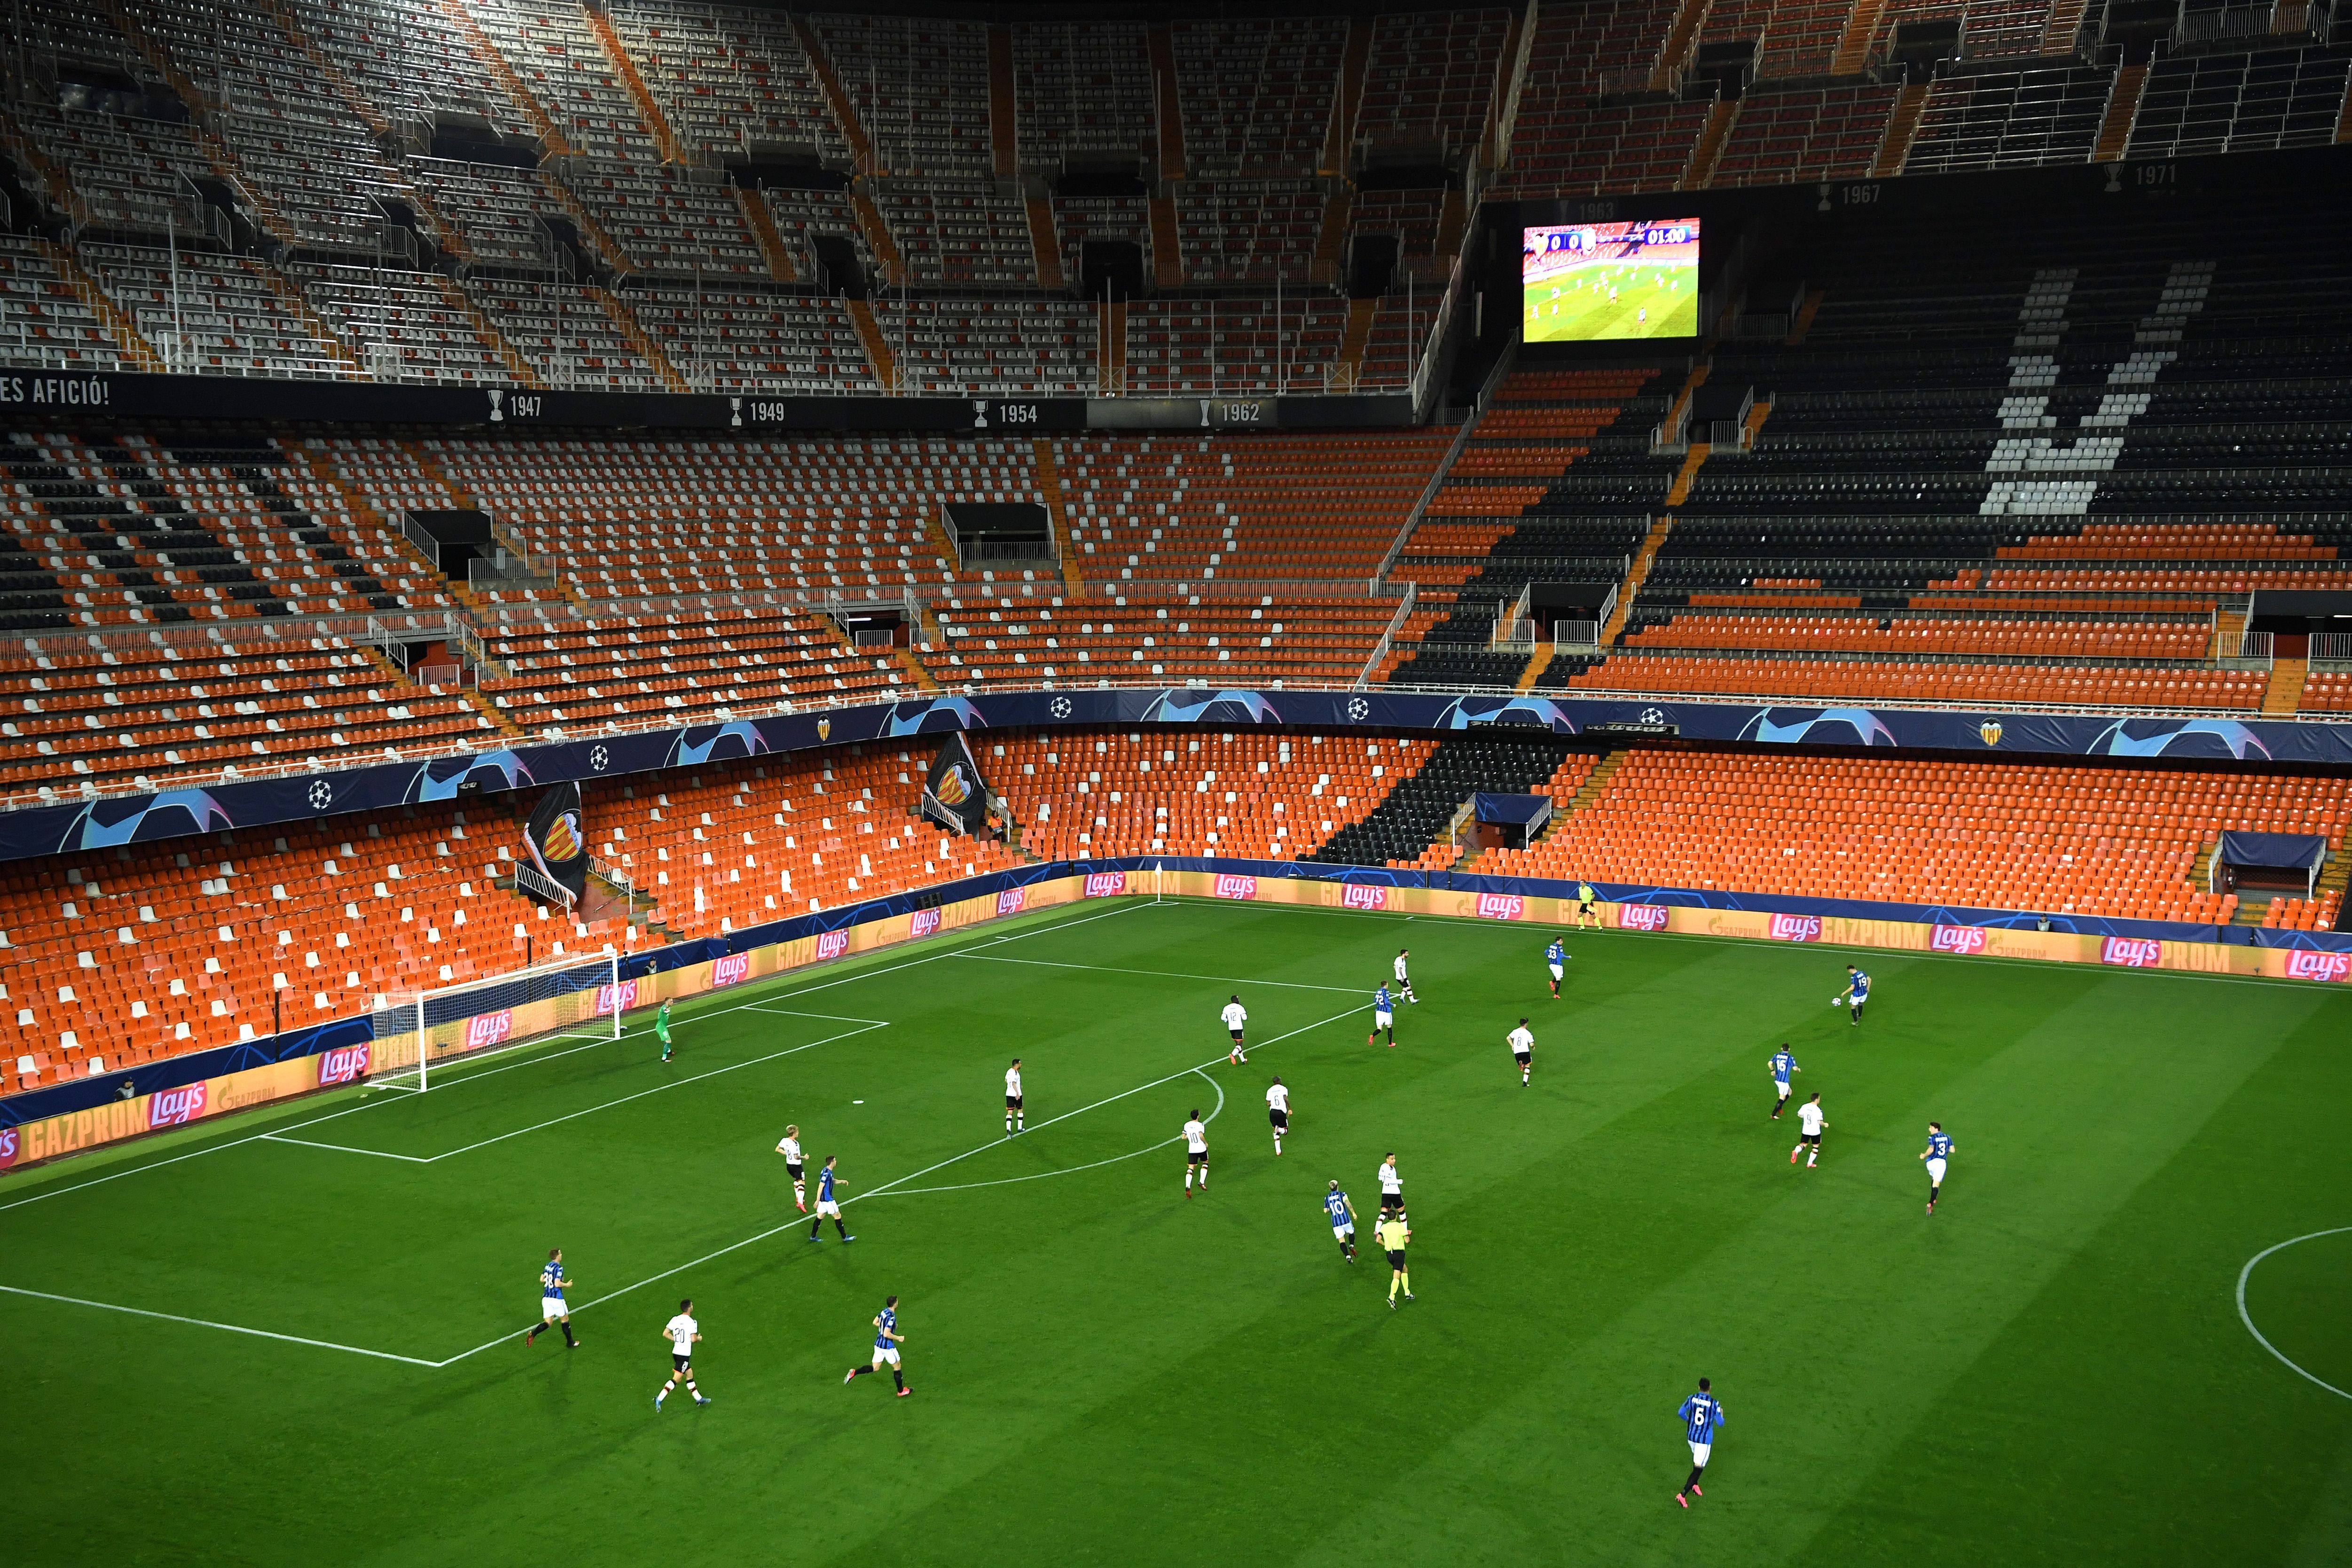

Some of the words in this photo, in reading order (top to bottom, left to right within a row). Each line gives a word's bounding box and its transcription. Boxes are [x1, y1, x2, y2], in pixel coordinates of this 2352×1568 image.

[2136, 163, 2176, 185] 1971
[1842, 185, 1880, 204] 1967
[1551, 235, 1560, 250] 0
[1569, 234, 1578, 249] 0
[1648, 228, 1685, 244] 01:00
[33, 375, 109, 405] AFICIÓ!
[511, 396, 541, 416] 1947
[751, 402, 784, 421] 1949
[1000, 405, 1037, 423] 1954
[1223, 403, 1259, 421] 1962
[1086, 871, 1123, 897] Lay's
[1216, 874, 1255, 900] Lay's
[997, 887, 1024, 914] Lay's
[1344, 884, 1384, 909] Lay's
[1479, 893, 1521, 920] Lay's
[912, 907, 940, 935] Lay's
[941, 895, 997, 930] GAZPROM
[1622, 903, 1667, 931] Lay's
[884, 931, 908, 942] GAZPROM
[1724, 926, 1761, 938] GAZPROM
[1772, 913, 1820, 941] Lay's
[1822, 917, 1924, 949] GAZPROM
[818, 929, 848, 958] Lay's
[1933, 925, 1984, 954] Lay's
[1548, 949, 1557, 959] 33
[2005, 947, 2046, 959] GAZPROM
[2104, 937, 2159, 967] Lay's
[714, 953, 747, 985] Lay's
[2289, 949, 2348, 981] Lay's
[1858, 977, 1866, 987] 19
[1231, 1012, 1237, 1021] 12
[468, 1009, 510, 1046] Lay's
[1517, 1037, 1521, 1046] 8
[321, 1044, 368, 1084] Lay's
[1777, 1059, 1786, 1072] 15
[150, 1082, 205, 1126] Lay's
[234, 1087, 275, 1107] GAZPROM
[1274, 1095, 1279, 1105] 6
[28, 1096, 149, 1160] GAZPROM
[1190, 1132, 1198, 1143] 10
[1937, 1143, 1945, 1156] 3
[1330, 1200, 1344, 1216] 10
[674, 1328, 684, 1343] 20
[1694, 1407, 1704, 1426] 6
